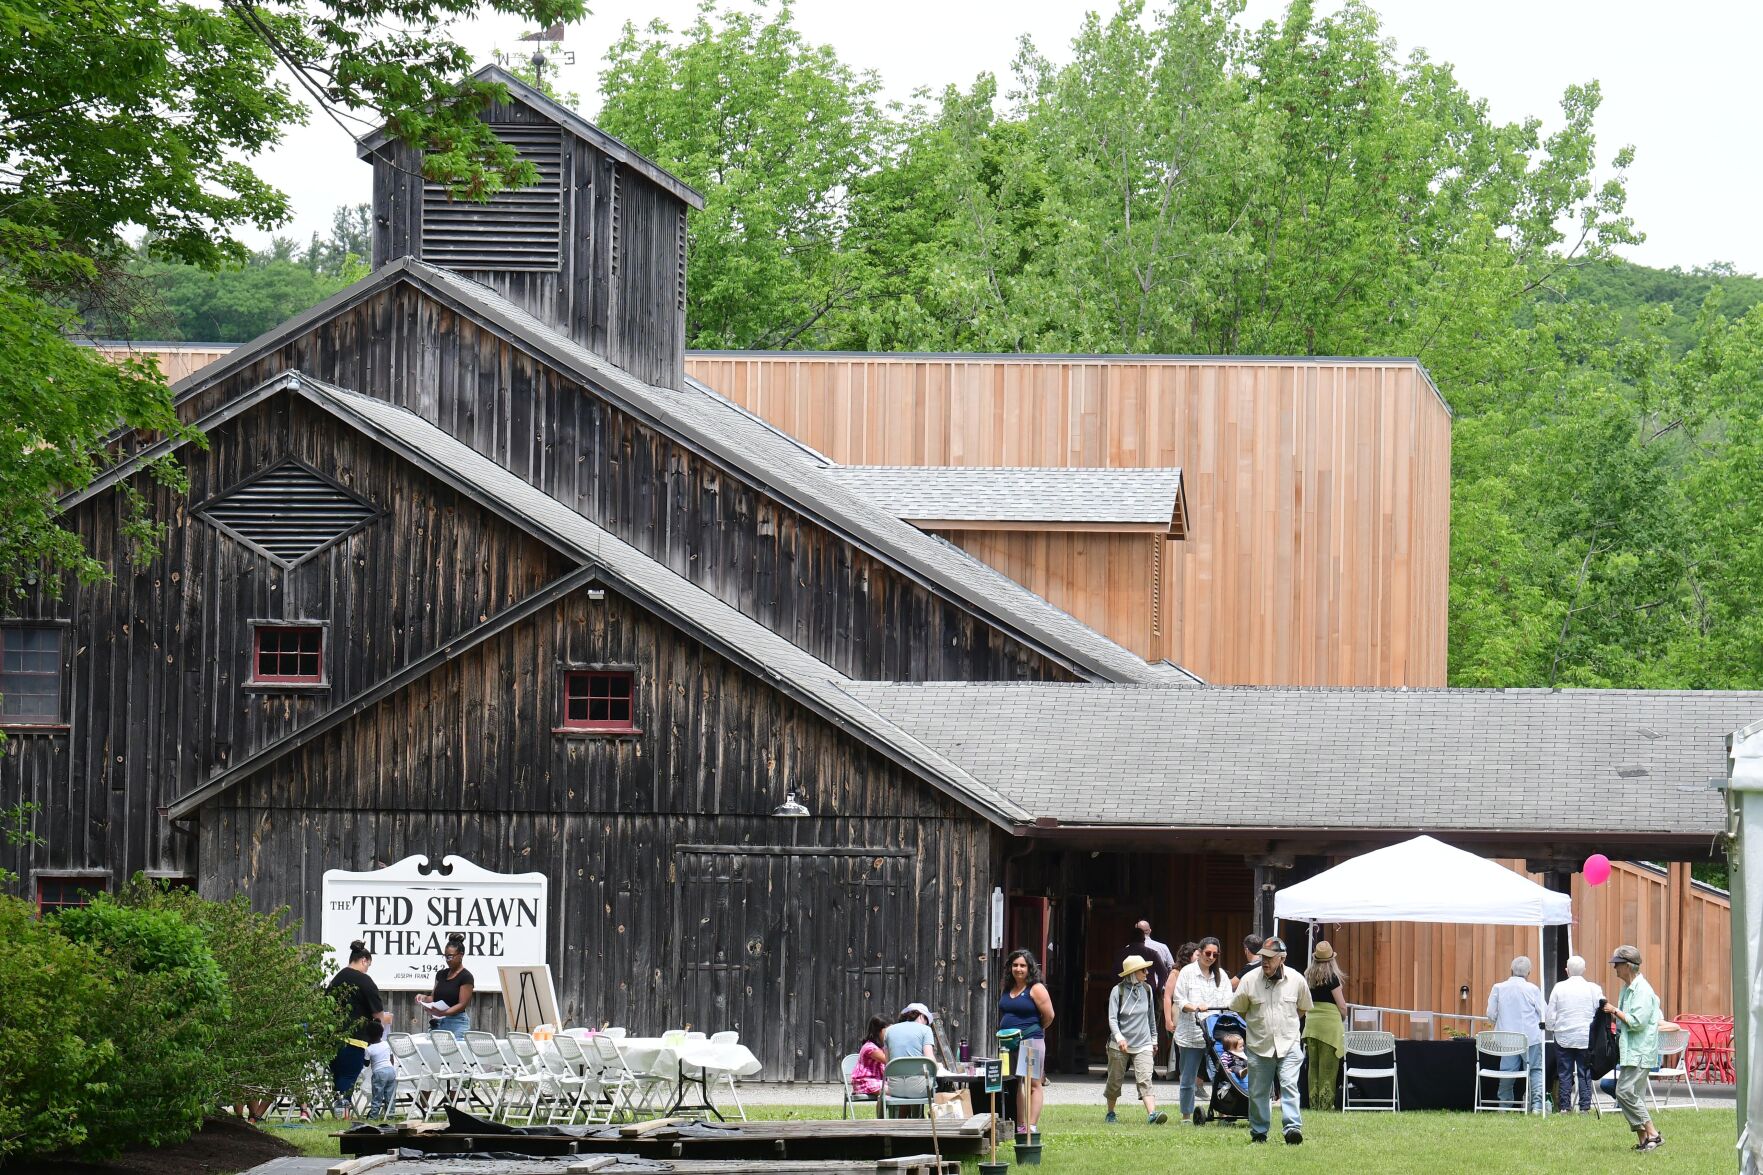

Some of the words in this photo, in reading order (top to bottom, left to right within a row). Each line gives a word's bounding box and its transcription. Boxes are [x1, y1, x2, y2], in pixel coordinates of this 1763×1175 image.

[330, 901, 352, 911] THE
[352, 895, 413, 926] TED
[427, 896, 539, 927] SHAWN
